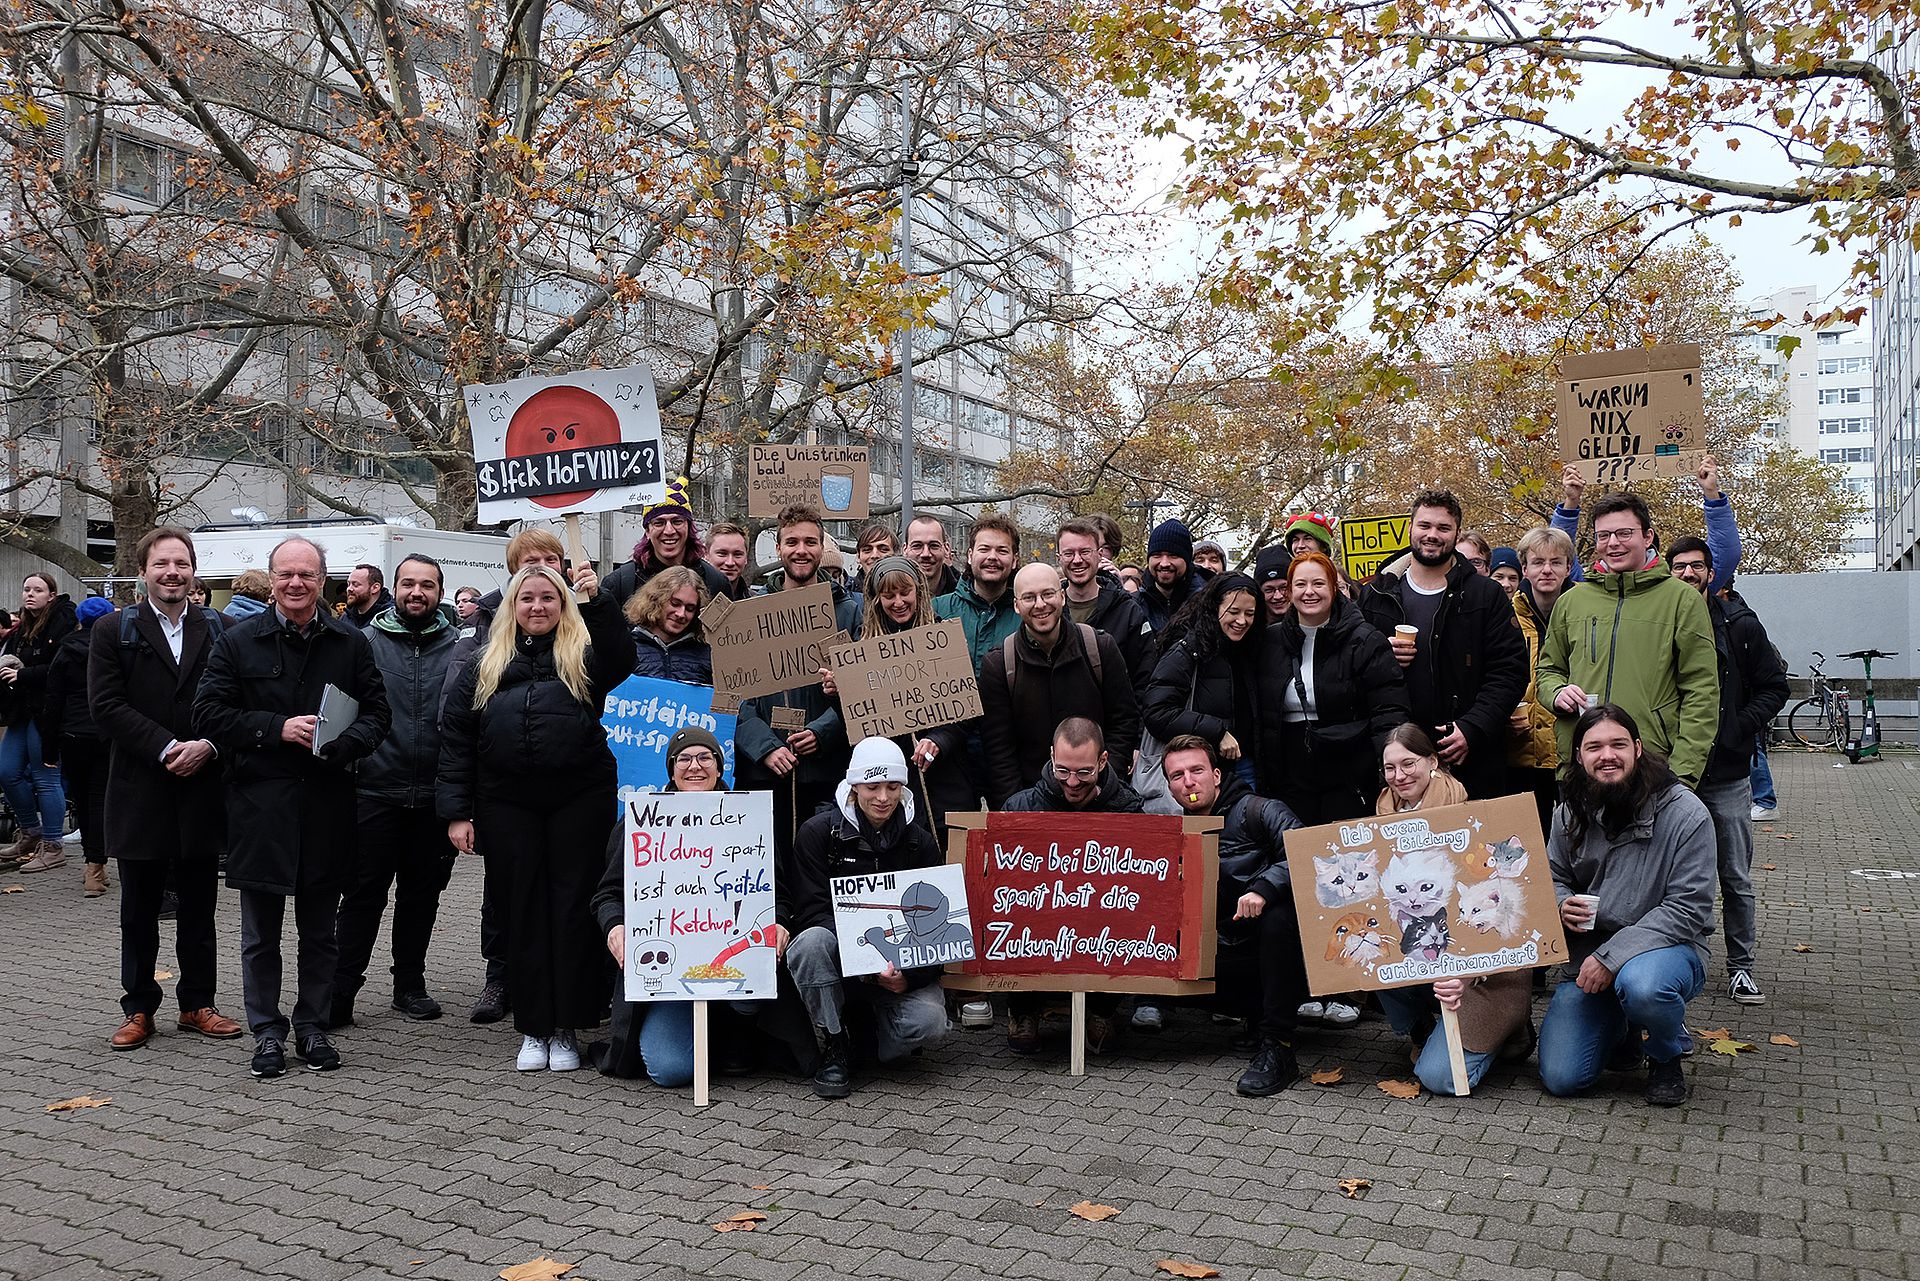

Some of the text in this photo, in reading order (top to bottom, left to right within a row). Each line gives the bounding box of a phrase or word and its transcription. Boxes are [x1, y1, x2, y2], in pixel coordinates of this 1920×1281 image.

[1578, 382, 1649, 409] WARUM
[1590, 410, 1633, 436] NIX
[753, 447, 779, 461] Die
[757, 461, 785, 475] bald
[479, 458, 541, 498] $!fck
[753, 473, 820, 490] schwäbische
[717, 602, 834, 647] ohne HUNNIES
[834, 630, 949, 668] ICH BIN SO
[722, 667, 762, 691] keine
[847, 676, 979, 720] ICH HAB SOGAR
[861, 718, 894, 738] EIN
[630, 798, 747, 828] Wer an der
[1341, 821, 1428, 846] Ich wenn
[1399, 832, 1468, 851] Bildung
[631, 831, 714, 868] Bildung
[994, 840, 1170, 882] Wer bei Bildung
[633, 868, 773, 902] isst auch Spätzle
[833, 874, 896, 896] HOFV-III
[992, 879, 1141, 915] spart hat die
[632, 909, 666, 937] mit
[898, 939, 975, 968] BILDUNG
[1379, 943, 1537, 982] unterfinanziert
